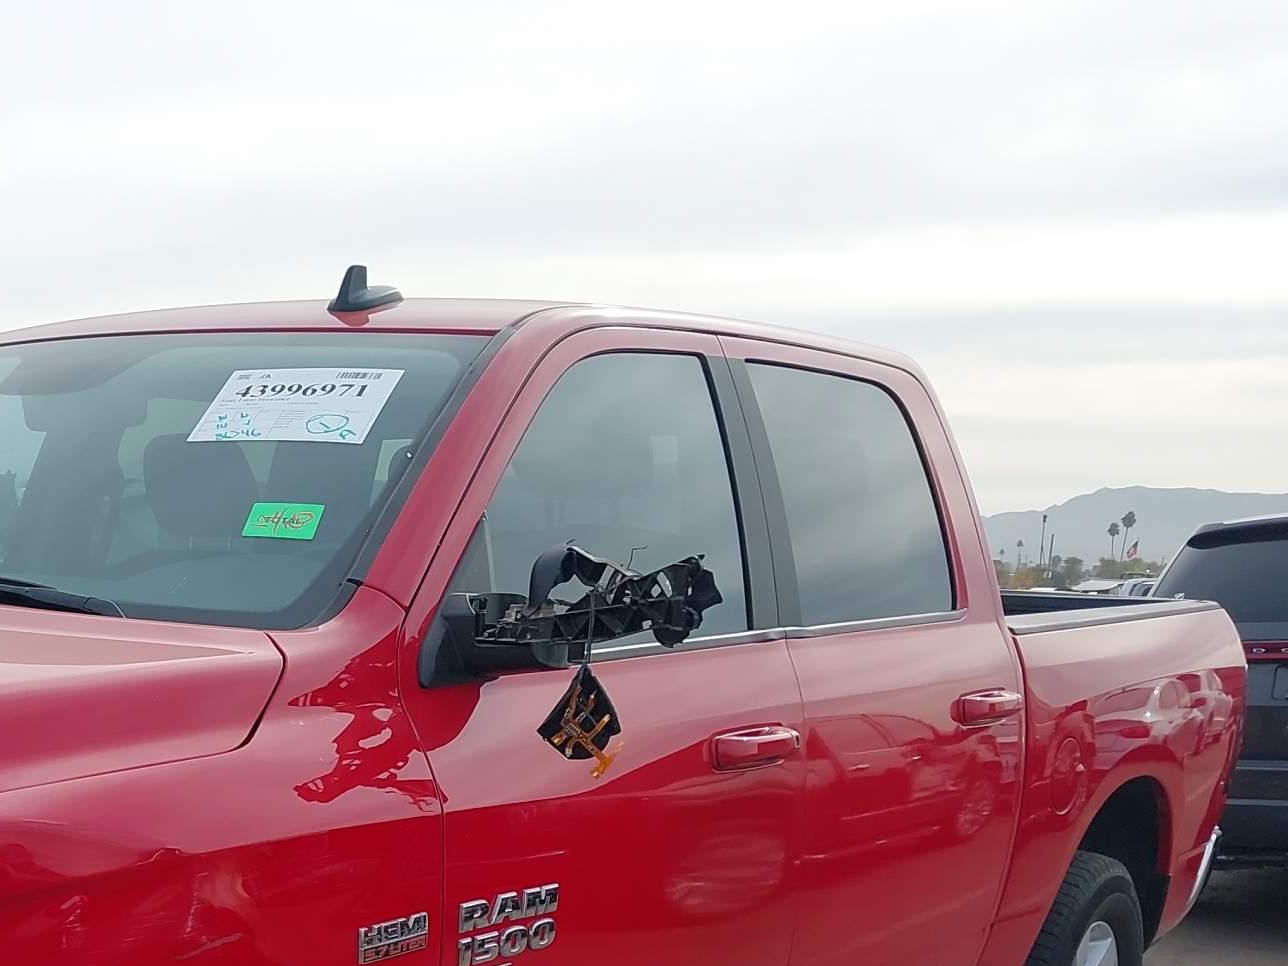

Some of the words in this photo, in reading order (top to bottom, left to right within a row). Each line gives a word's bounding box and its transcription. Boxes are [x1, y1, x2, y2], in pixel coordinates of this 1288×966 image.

[235, 383, 369, 398] 43996971
[460, 883, 559, 933] RAM
[359, 912, 428, 949] HEMI
